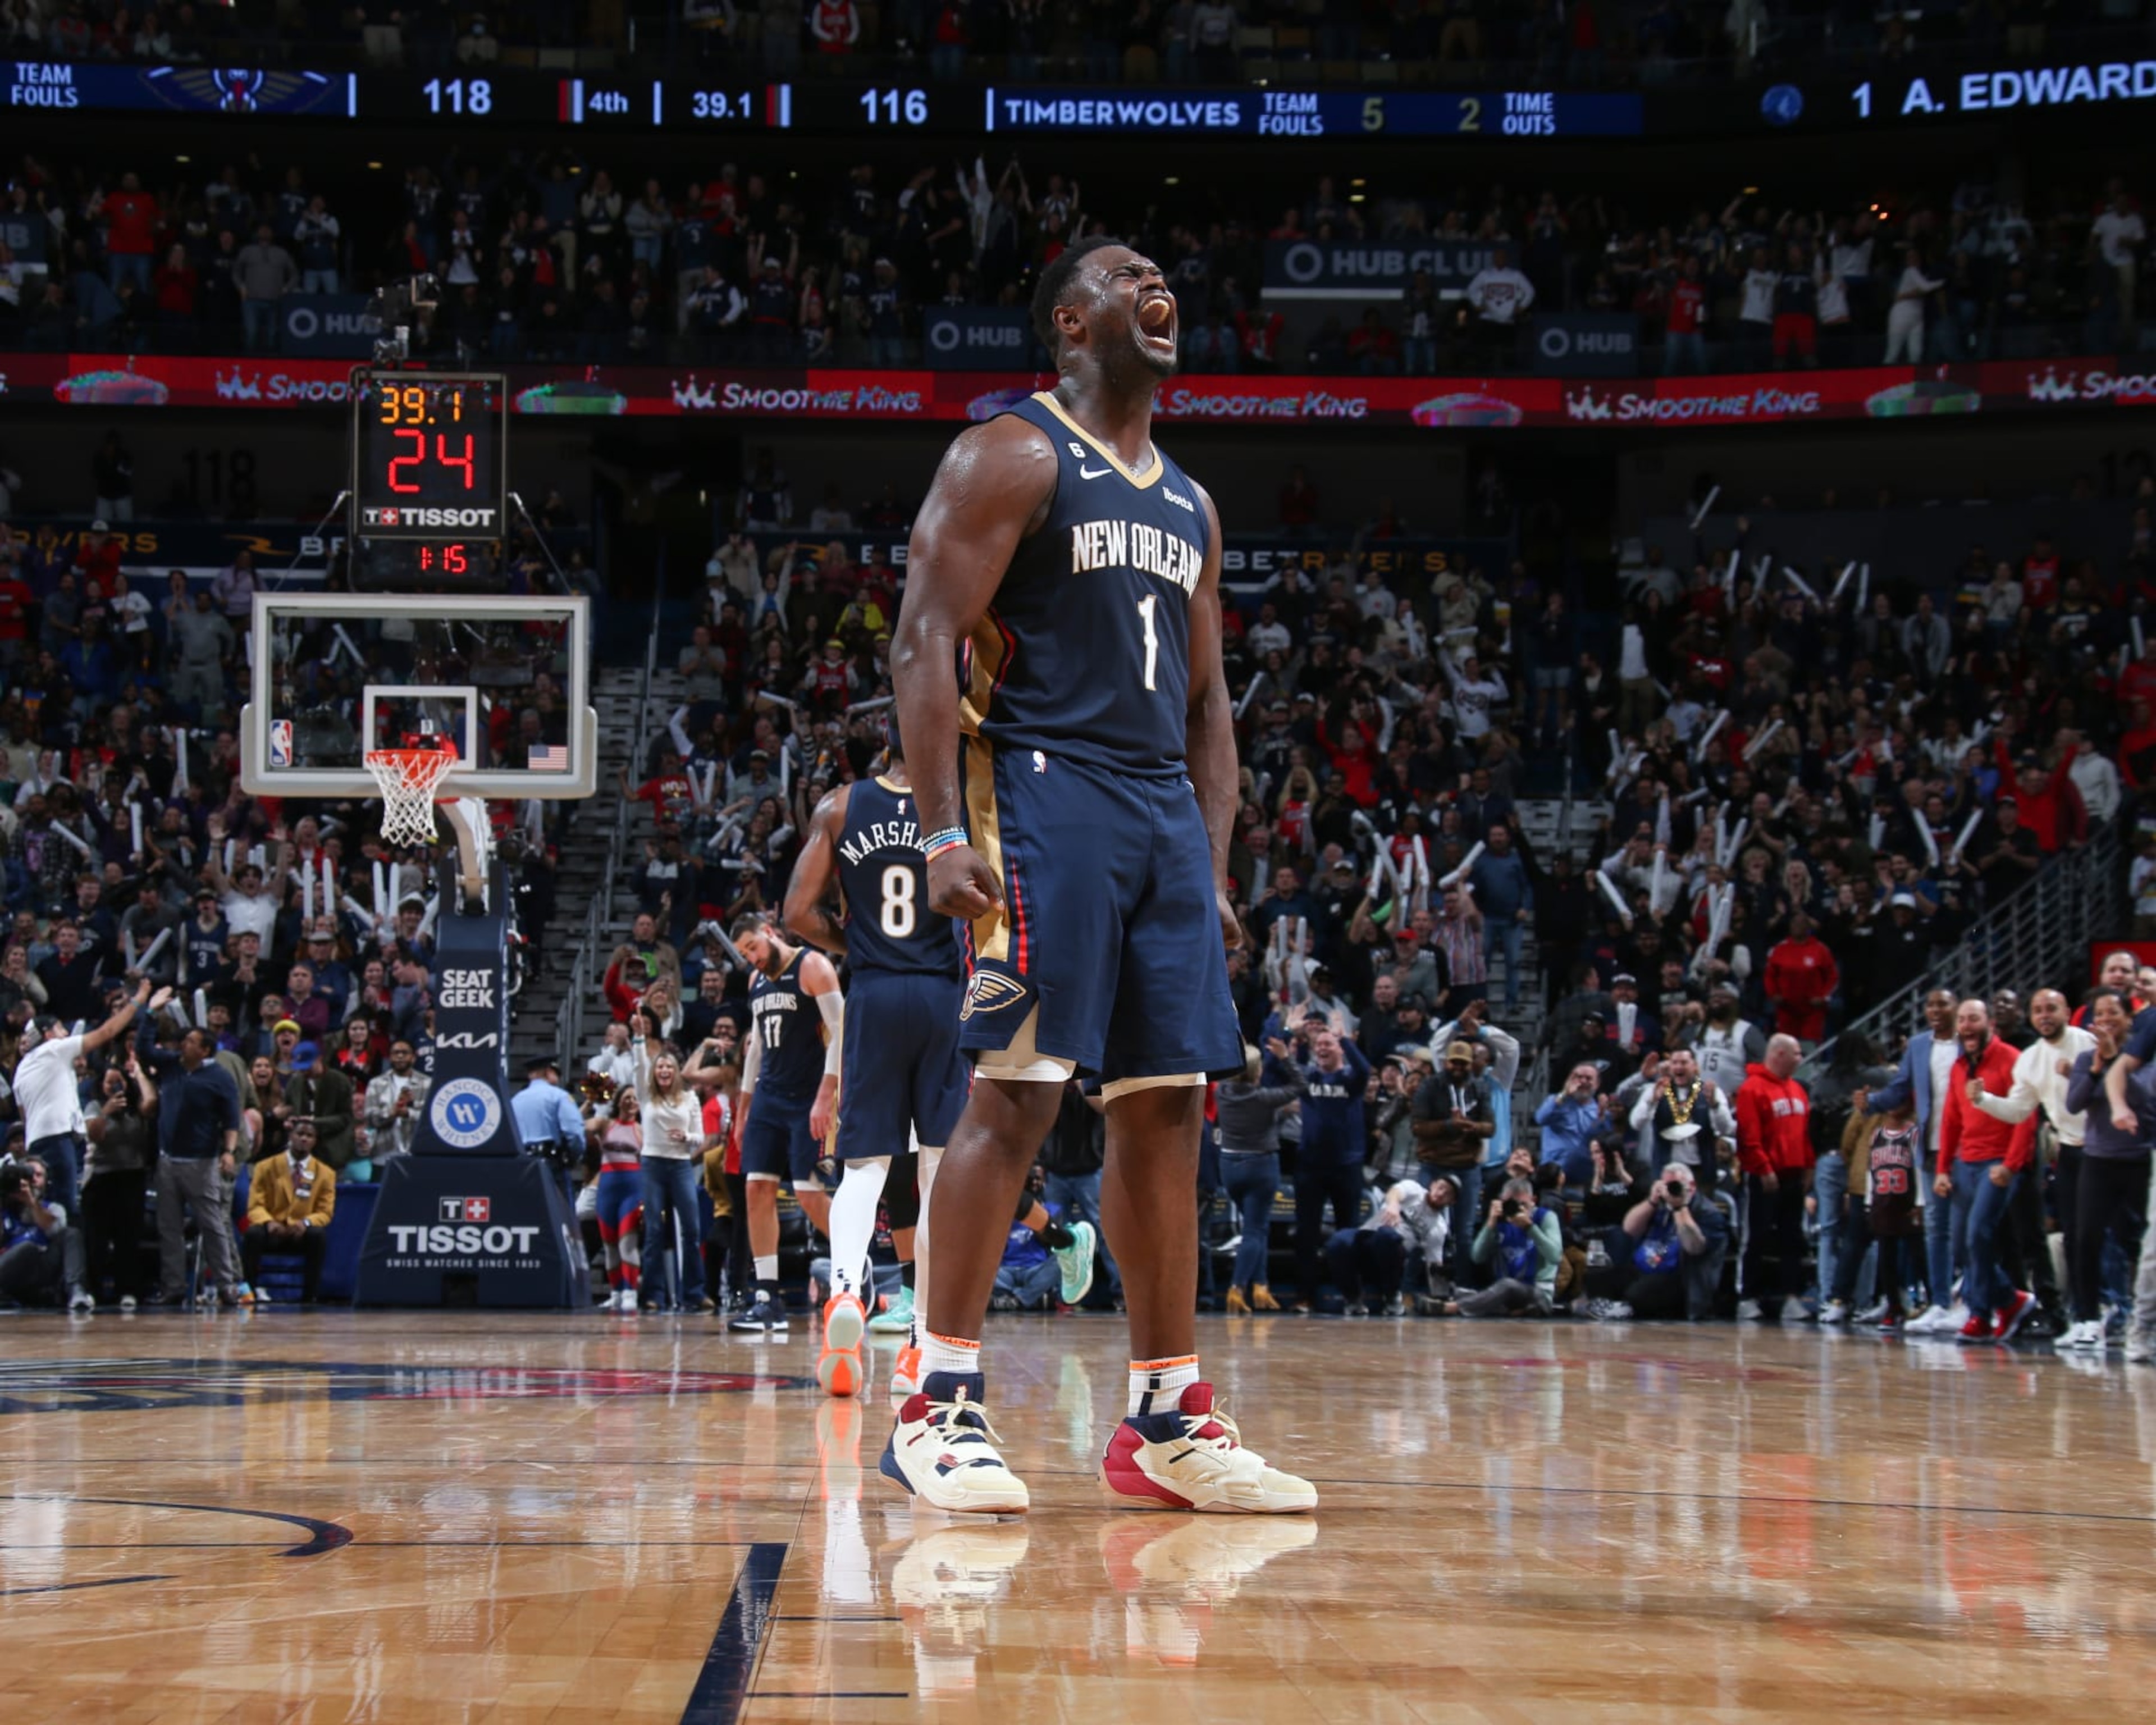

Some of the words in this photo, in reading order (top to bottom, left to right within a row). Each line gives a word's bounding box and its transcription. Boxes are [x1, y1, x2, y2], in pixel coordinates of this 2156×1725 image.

[16, 62, 72, 84] TEAM
[11, 85, 78, 107] FOULS
[423, 79, 491, 114] 118
[589, 92, 628, 113] 4th
[1852, 82, 1871, 118] 1
[1902, 78, 1945, 115] A.
[1961, 61, 2156, 110] EDWARD
[692, 92, 751, 118] 39.1
[861, 88, 928, 124] 116
[1006, 99, 1240, 126] TIMBERWOLVES
[1263, 93, 1318, 113] TEAM
[1362, 97, 1384, 131] 5
[1459, 98, 1481, 131] 2
[1504, 93, 1554, 113] TIME
[1259, 115, 1323, 135] FOULS
[1502, 115, 1555, 135] OUTS
[1331, 249, 1405, 276] HUB
[1409, 249, 1493, 276] CLU
[967, 327, 1022, 346] HUB
[1577, 333, 1632, 353] HUB
[380, 387, 460, 425] 39.1
[387, 428, 473, 493] 24
[1068, 442, 1086, 459] 6
[401, 508, 495, 527] TISSOT
[1071, 519, 1127, 575] NEW
[1137, 593, 1158, 692] 1
[880, 864, 916, 939] 8
[442, 969, 494, 989] SEAT
[439, 989, 495, 1008] GEEK
[764, 1014, 782, 1048] 17
[435, 1080, 497, 1107] HANCOCK
[436, 1117, 497, 1144] WHITNEY
[1876, 1169, 1908, 1194] 33
[387, 1225, 540, 1254] TISSOT
[386, 1258, 421, 1268] SWISS
[424, 1258, 473, 1268] WATCHES
[478, 1258, 510, 1268] SINCE
